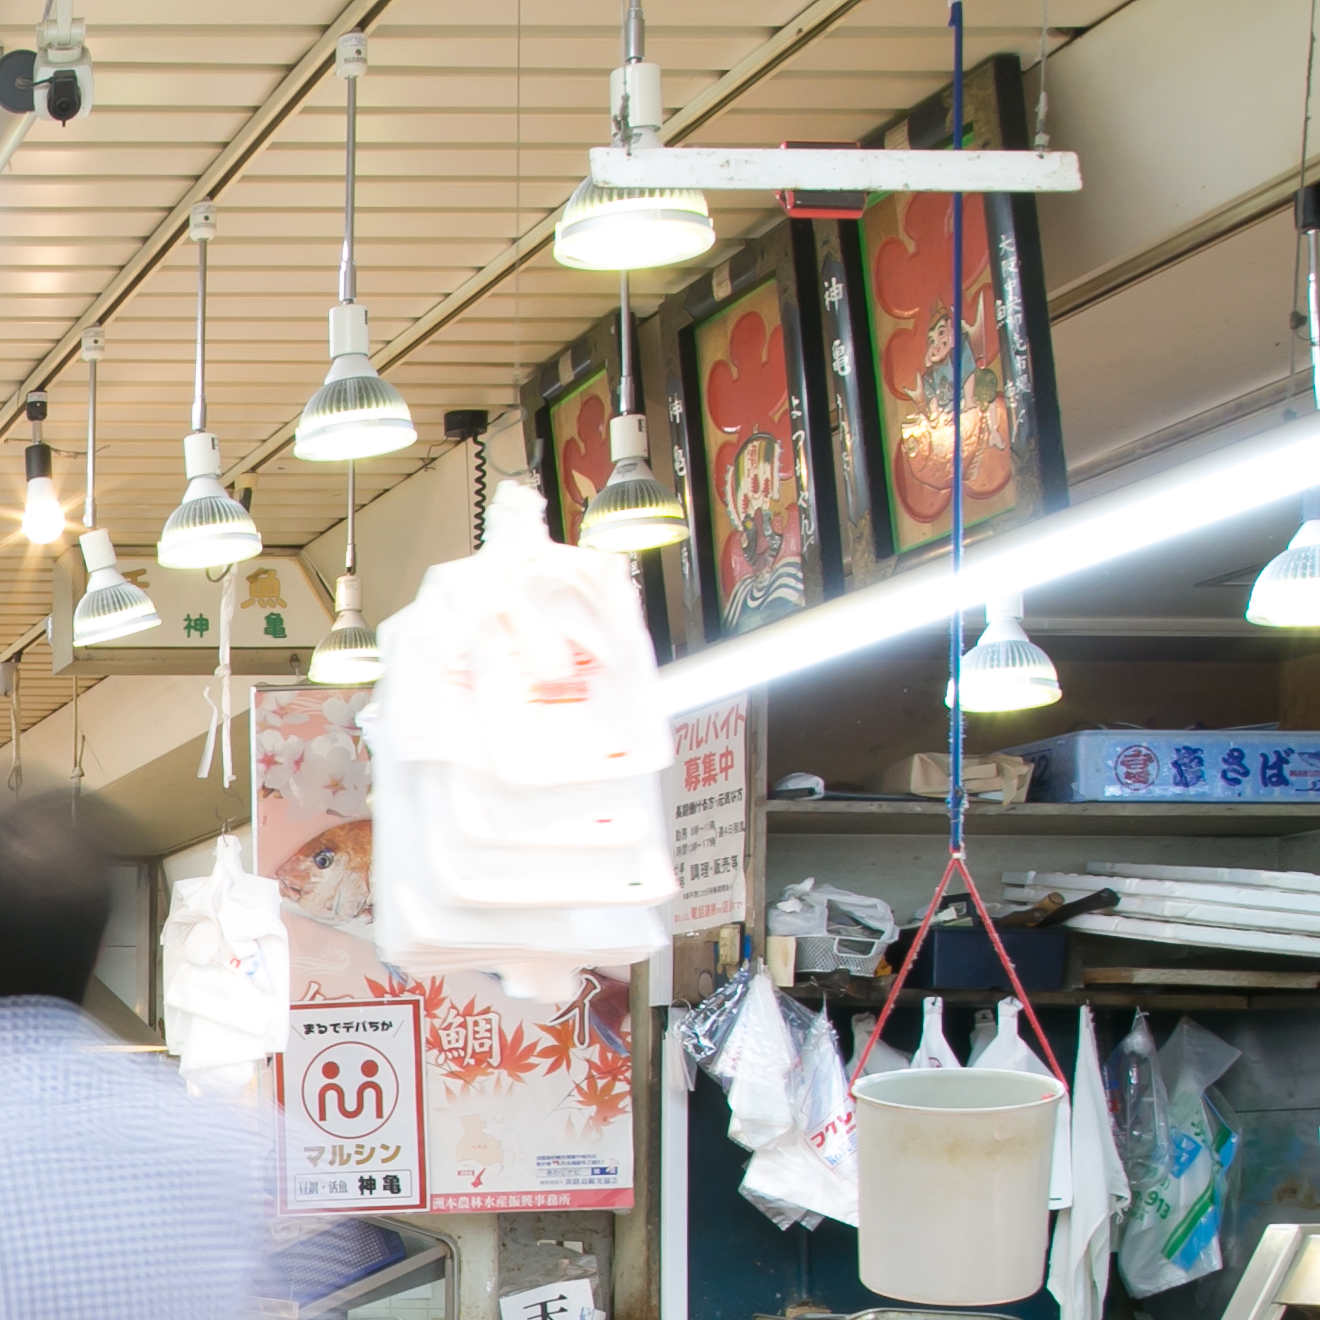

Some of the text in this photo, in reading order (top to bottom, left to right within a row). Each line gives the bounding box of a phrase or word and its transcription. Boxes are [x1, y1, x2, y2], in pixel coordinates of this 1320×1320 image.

[183, 612, 288, 640] 神亀
[674, 703, 746, 756] アルバイト
[683, 745, 735, 793] 募集中
[302, 1020, 394, 1036] まるでデパちか
[436, 1007, 502, 1068] 鯛
[303, 1143, 402, 1168] マルシン
[358, 1174, 402, 1196] 神亀
